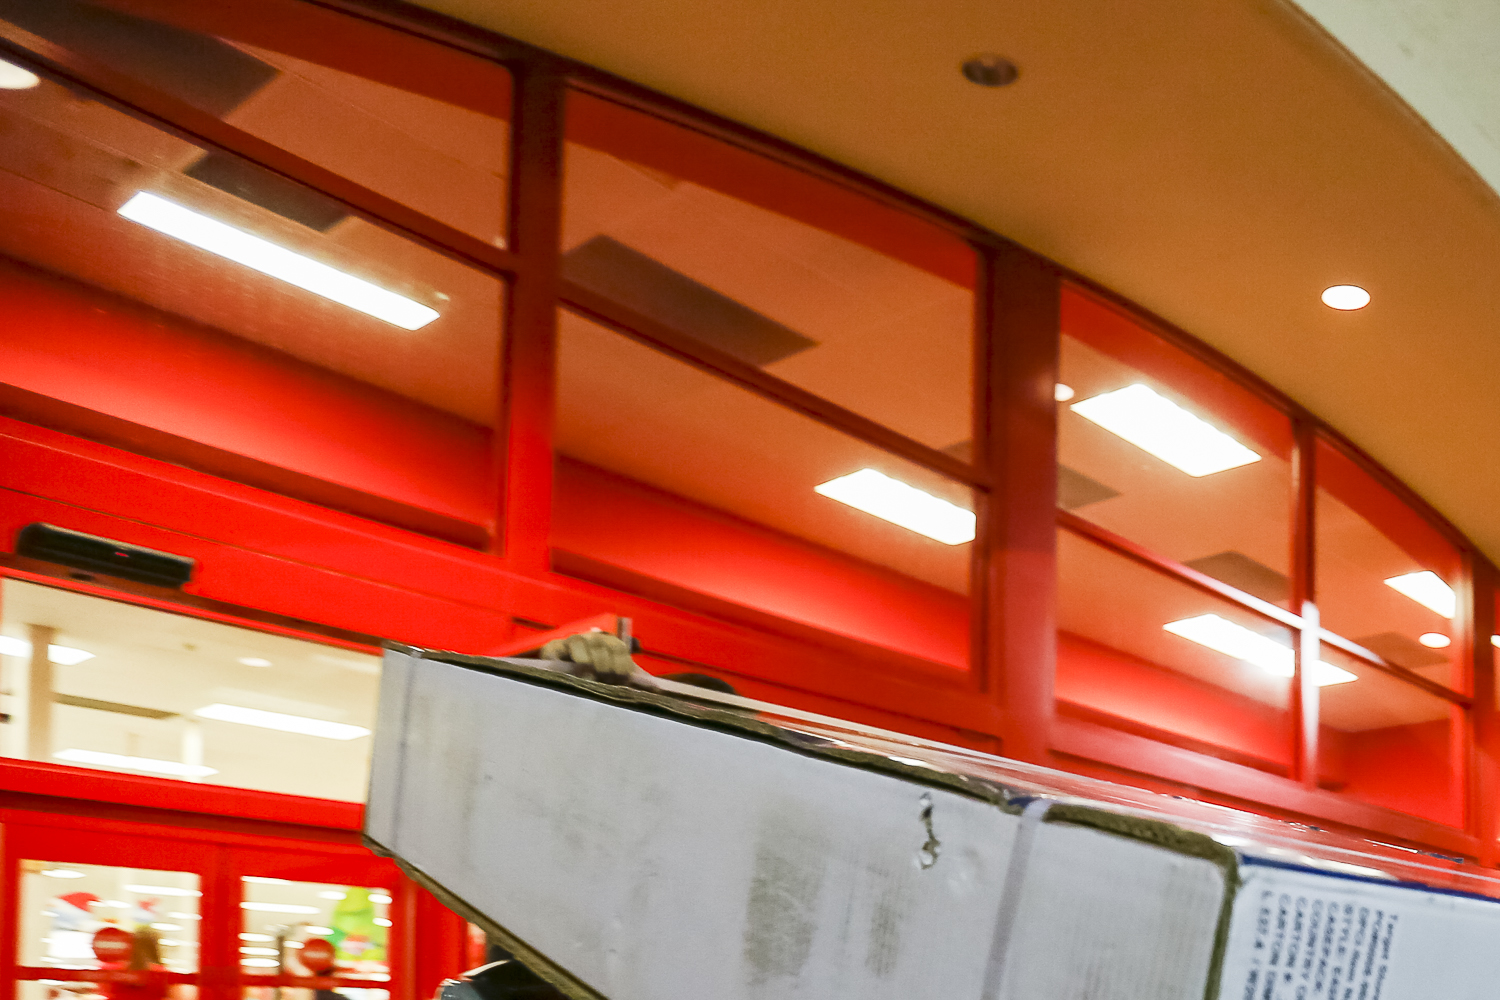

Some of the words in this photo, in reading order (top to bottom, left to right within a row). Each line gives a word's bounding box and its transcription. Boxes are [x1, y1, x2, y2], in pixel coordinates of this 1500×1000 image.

[1270, 893, 1289, 966] CARTON
[1286, 896, 1305, 968] CARTON
[1300, 898, 1322, 980] COUNTRY
[1379, 913, 1397, 960] Target
